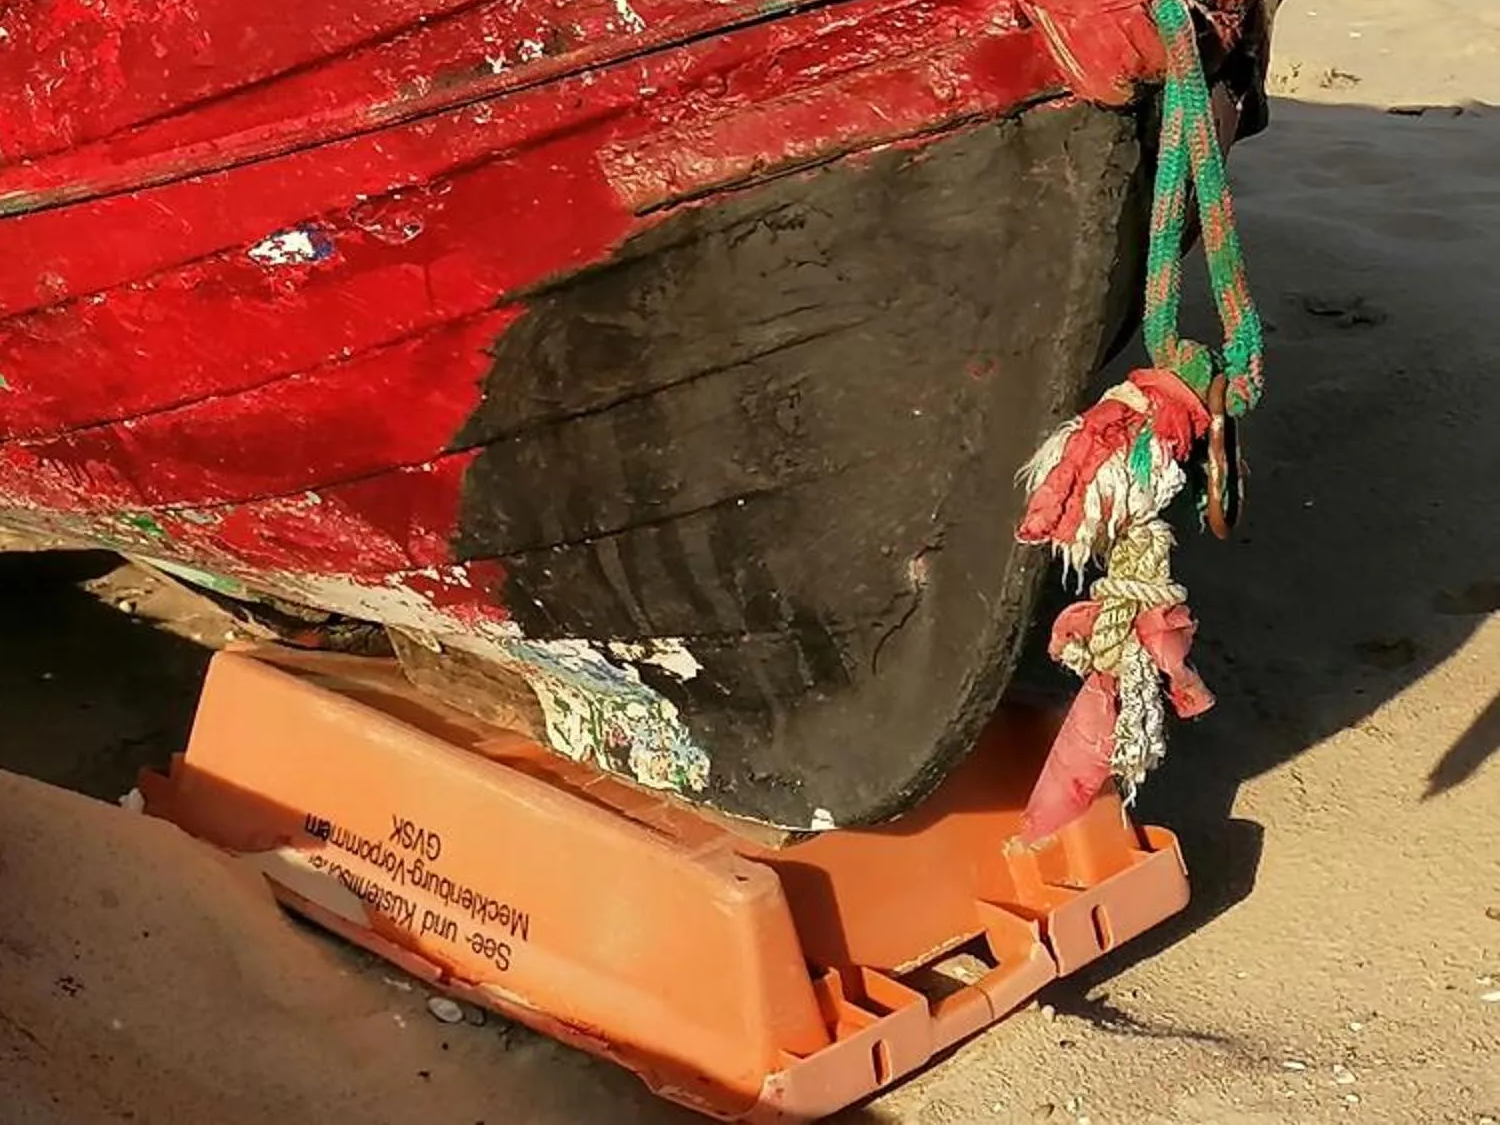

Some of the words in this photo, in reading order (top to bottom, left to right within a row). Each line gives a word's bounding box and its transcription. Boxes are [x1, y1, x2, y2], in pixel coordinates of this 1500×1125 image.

[390, 814, 442, 861] GVSK
[304, 813, 530, 941] Mecklenburg-Vorpommern
[420, 908, 459, 942] und
[465, 932, 512, 972] See-
